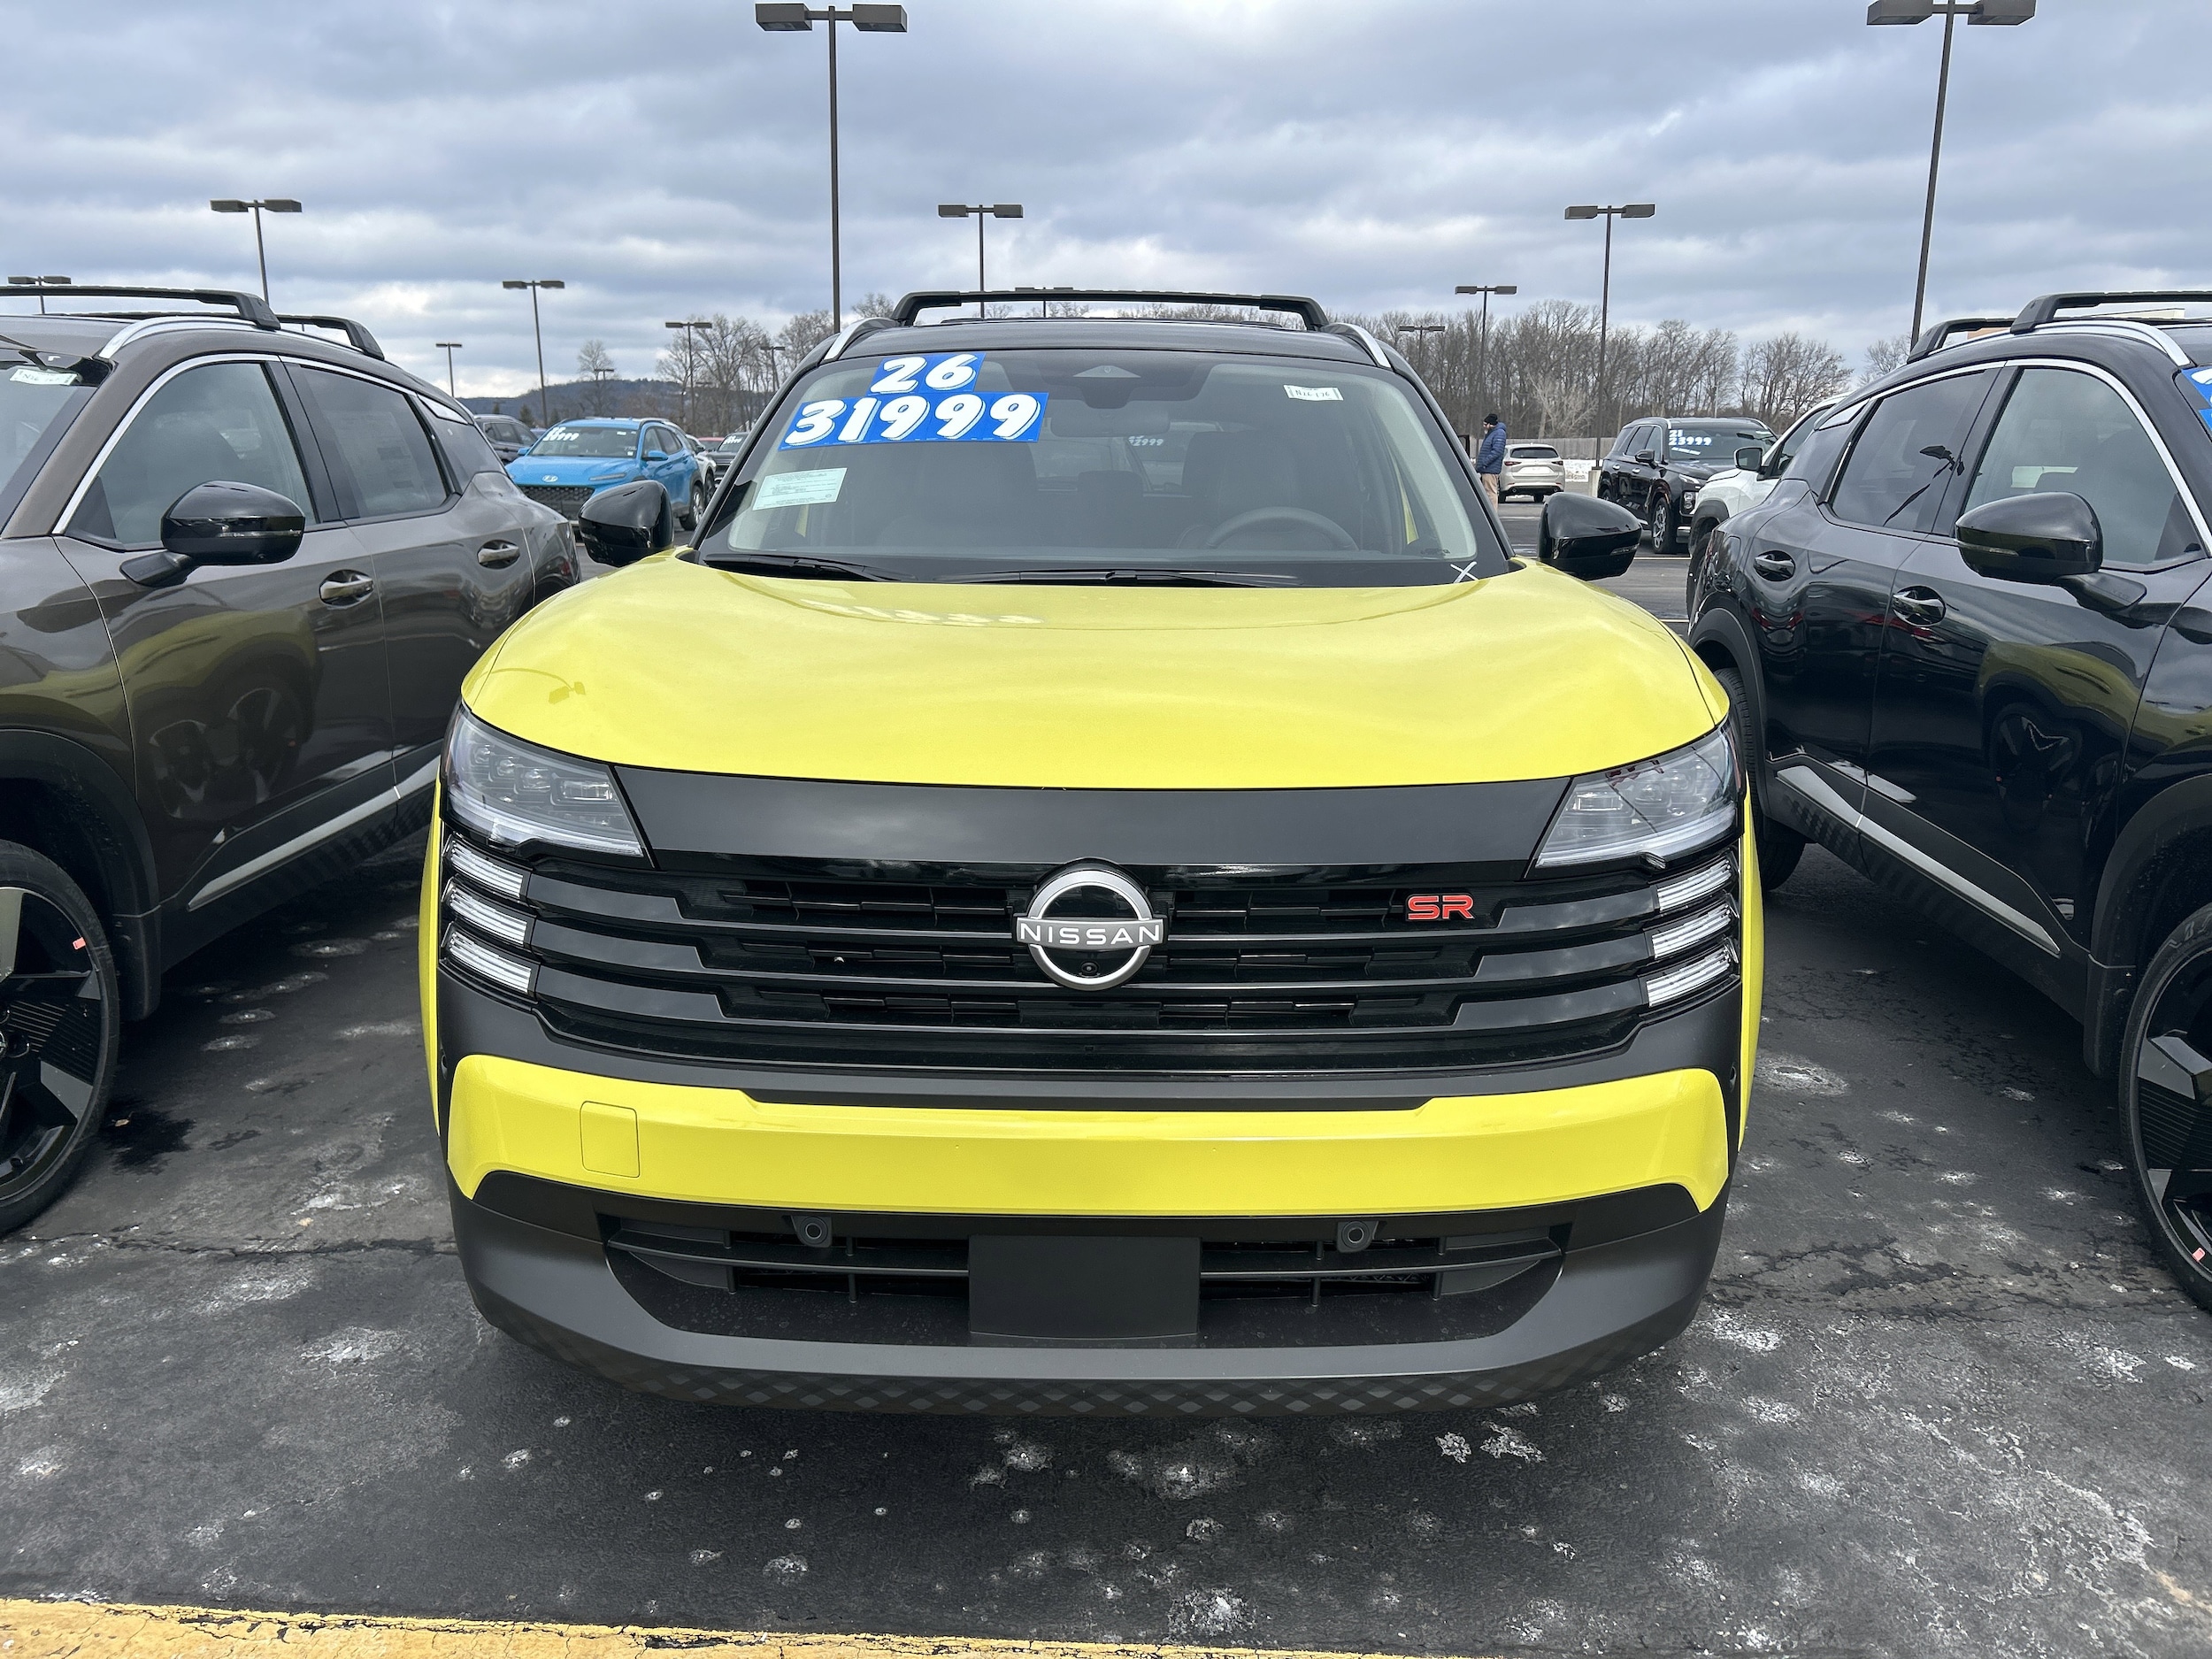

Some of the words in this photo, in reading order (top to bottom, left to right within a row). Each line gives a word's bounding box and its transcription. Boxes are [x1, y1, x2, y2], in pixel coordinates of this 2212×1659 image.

[870, 354, 978, 395] 26
[785, 394, 1041, 446] 31999
[1669, 436, 1712, 446] 23999
[1406, 894, 1475, 920] SR
[1019, 922, 1161, 946] NISSAN
